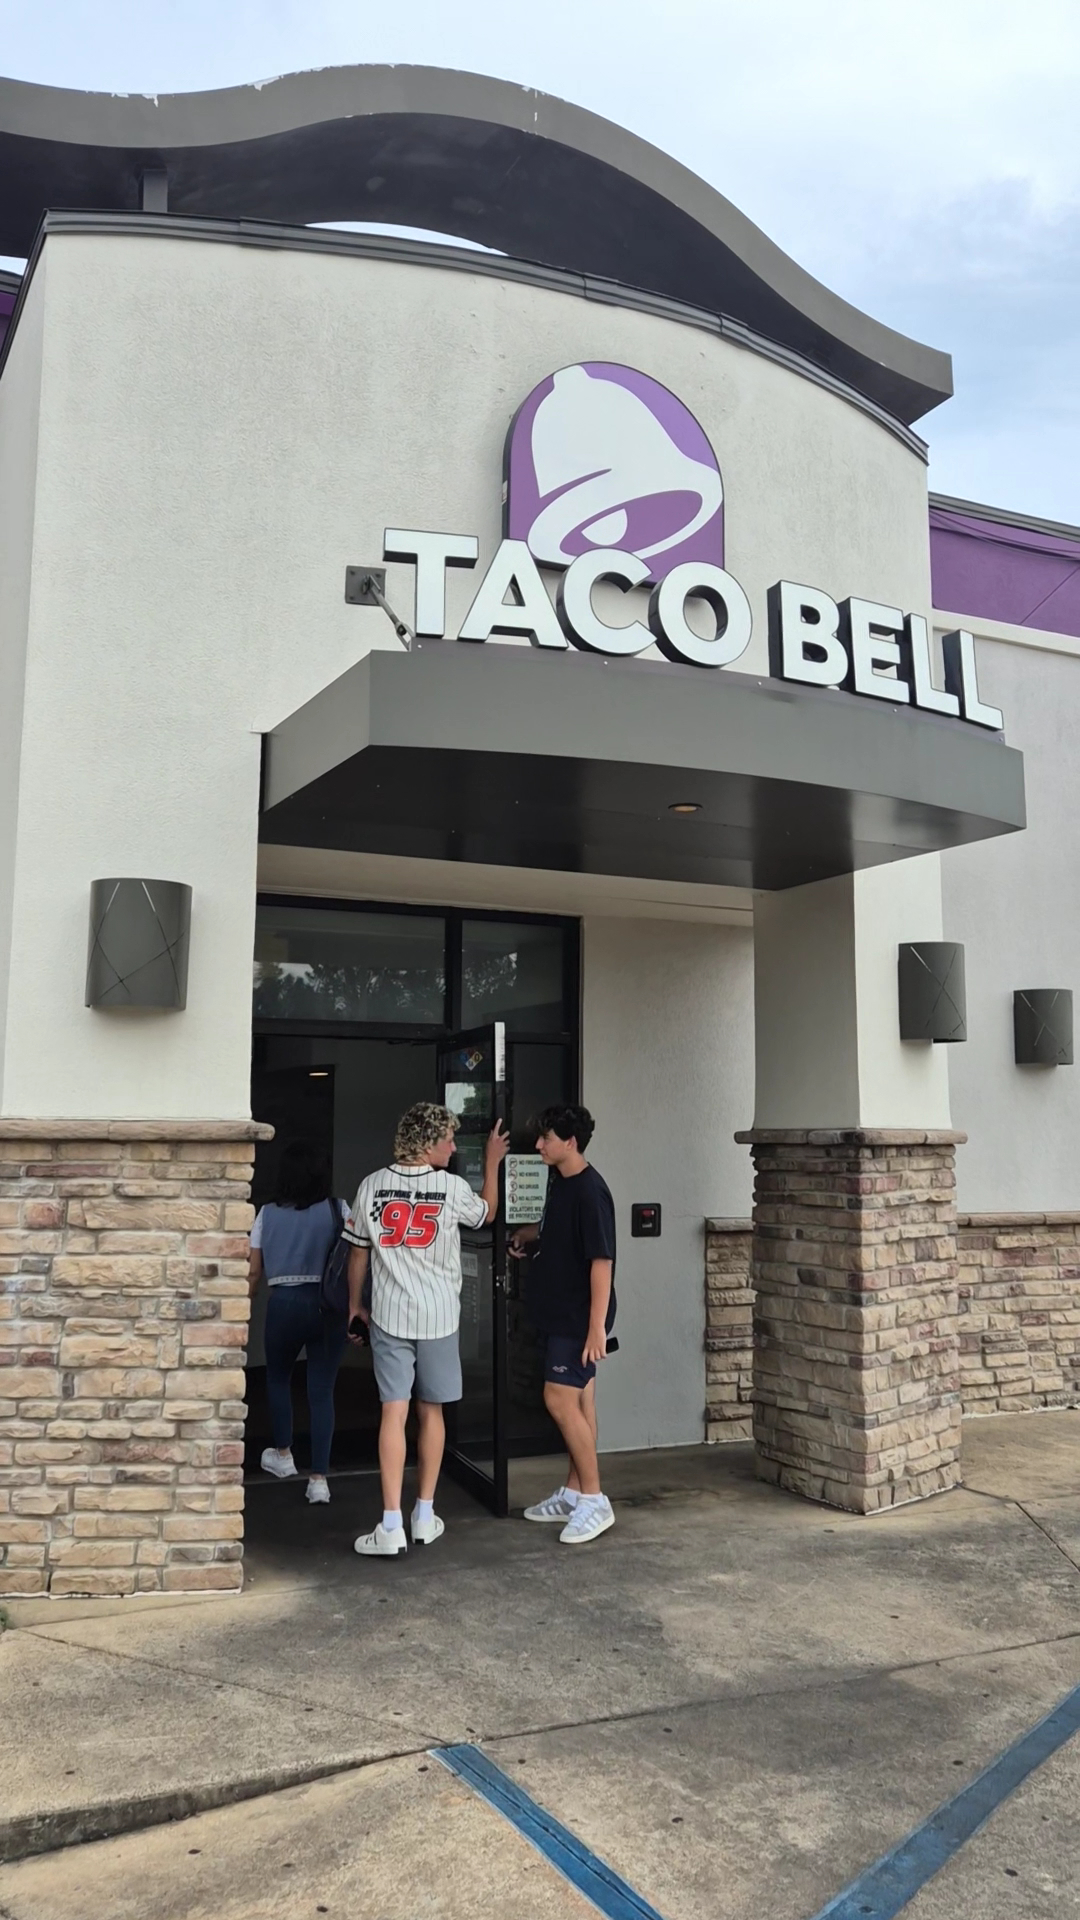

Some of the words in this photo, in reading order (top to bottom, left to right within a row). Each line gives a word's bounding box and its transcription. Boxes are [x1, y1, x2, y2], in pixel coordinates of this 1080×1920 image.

[383, 527, 753, 669] TACO
[767, 579, 1004, 730] BELL
[379, 1200, 443, 1248] 95
